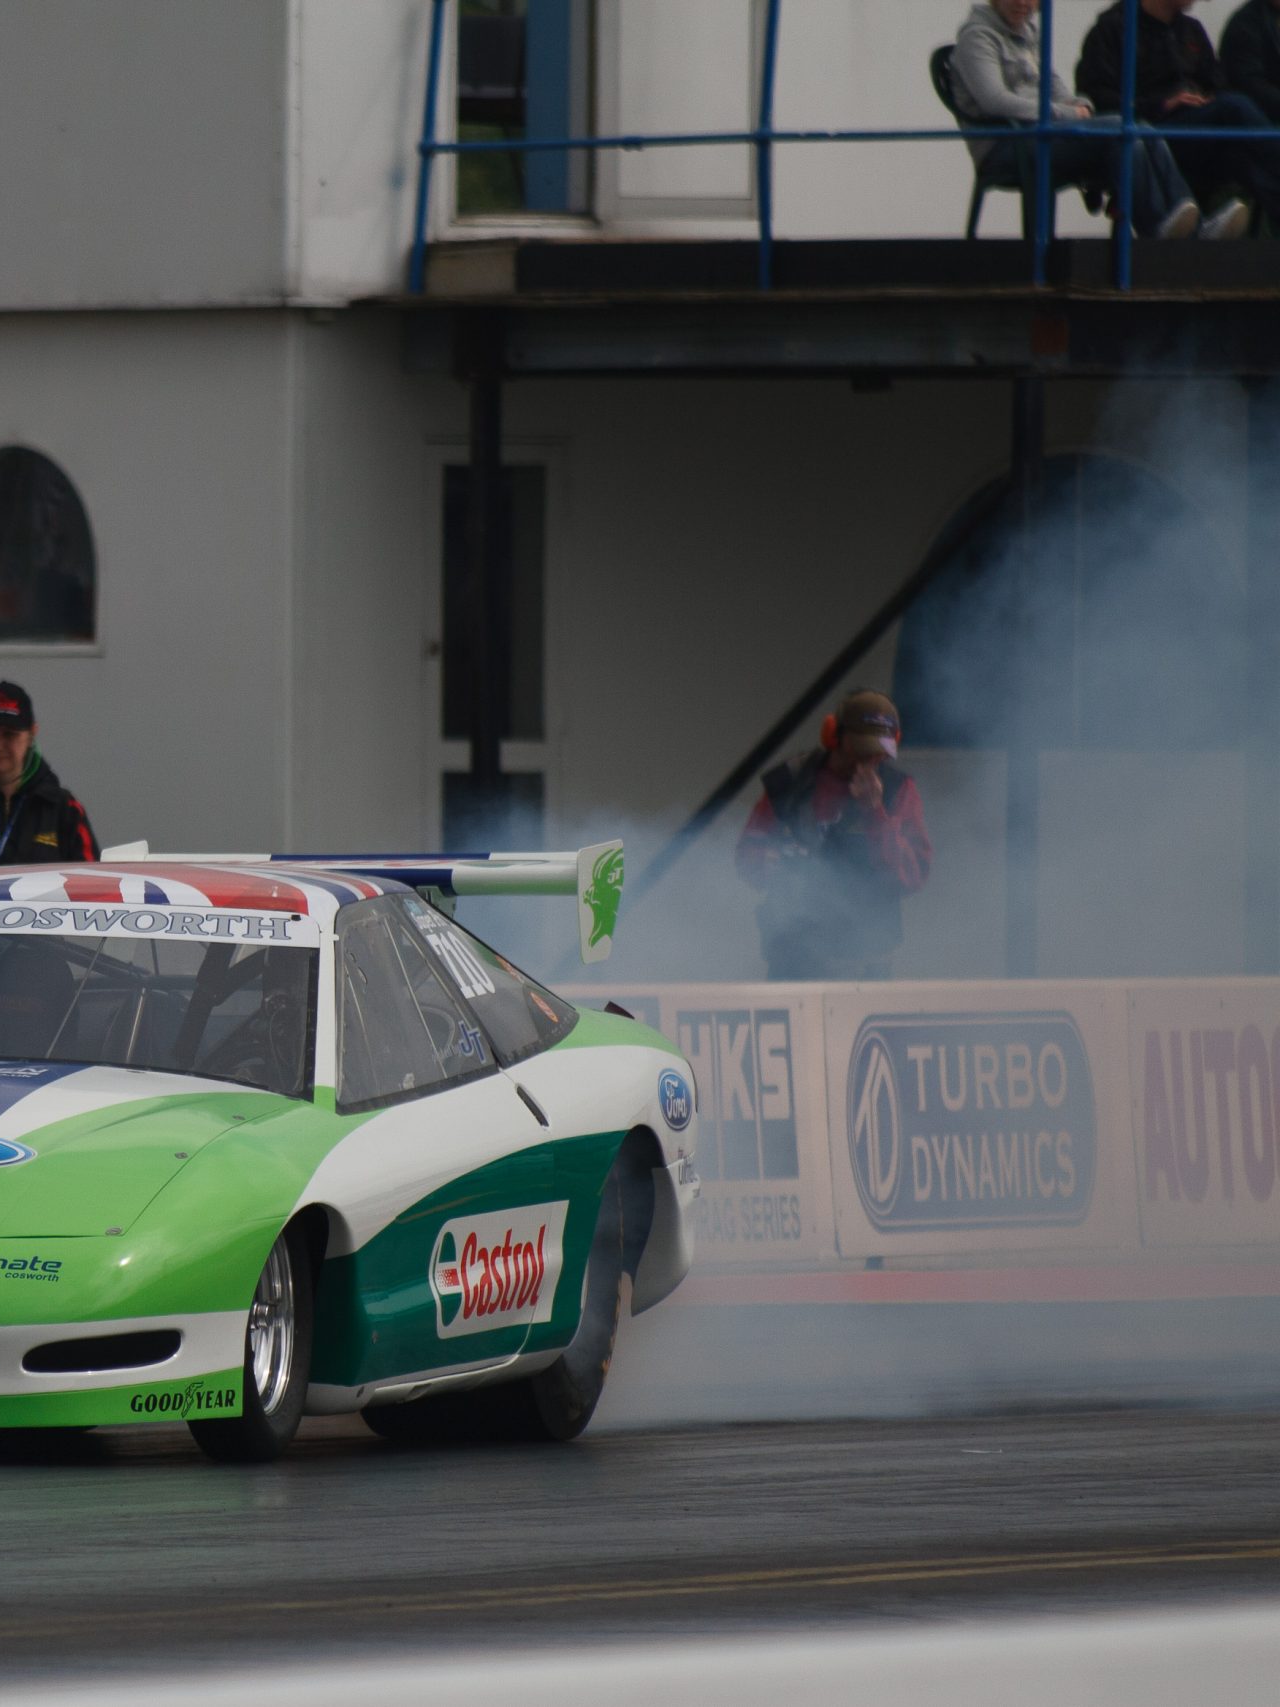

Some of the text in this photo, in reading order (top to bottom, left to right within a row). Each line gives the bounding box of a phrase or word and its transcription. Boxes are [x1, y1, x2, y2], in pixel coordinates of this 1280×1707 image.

[458, 1020, 487, 1065] JT
[680, 1022, 791, 1121] HKS
[907, 1042, 1068, 1113] TURBO
[665, 1078, 688, 1120] Ford
[1143, 1023, 1280, 1203] AUTO
[910, 1131, 1077, 1202] DYNAMICS
[740, 1194, 802, 1241] SERIES
[4, 1271, 60, 1283] cosworth
[459, 1222, 548, 1321] Castrol
